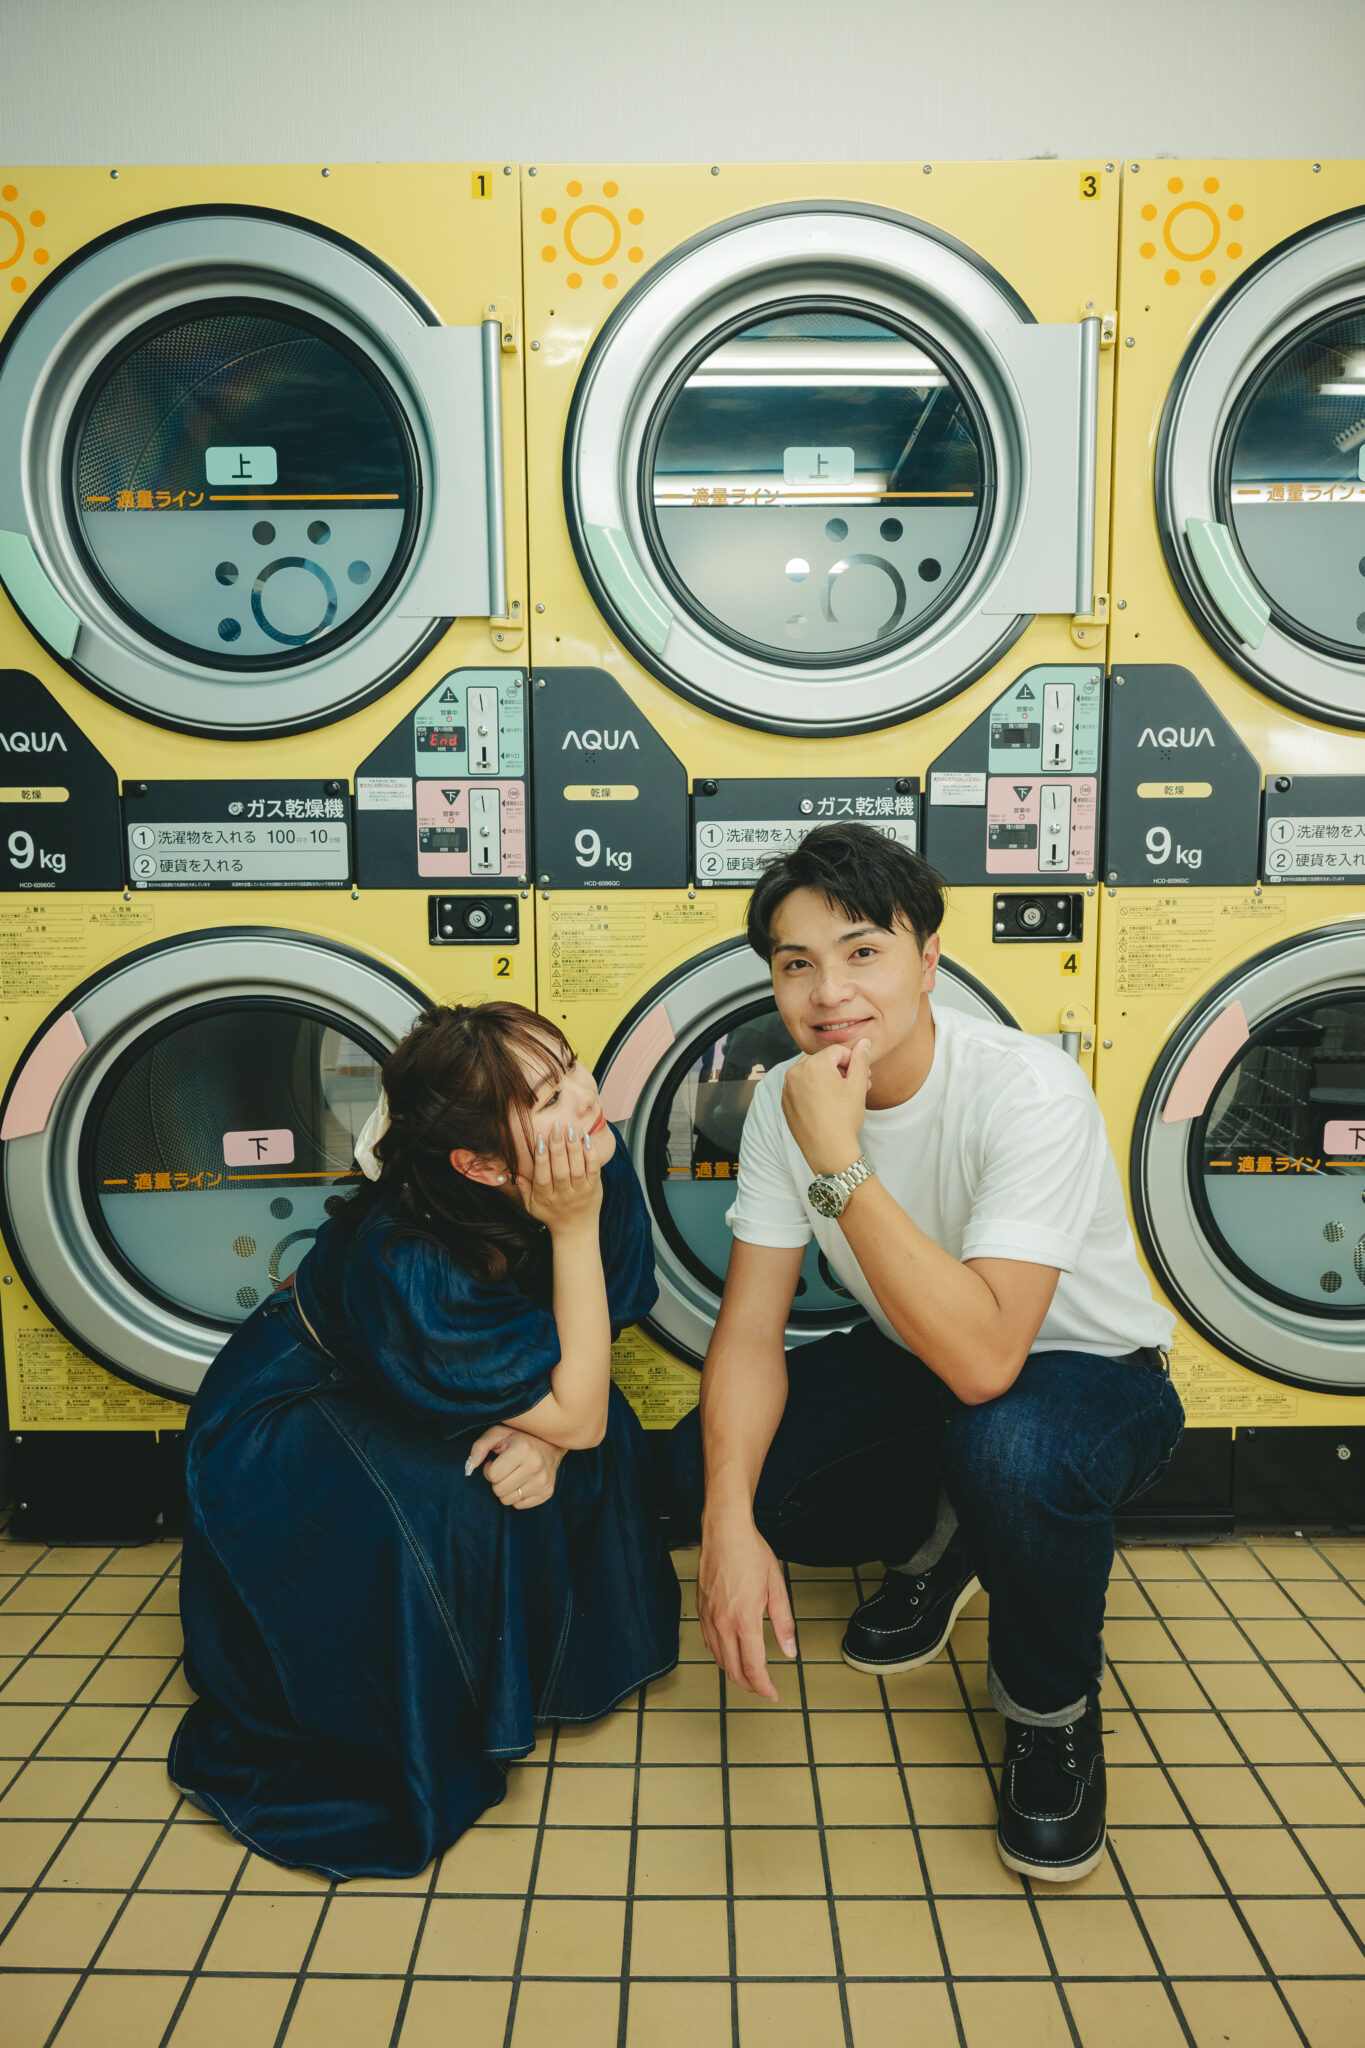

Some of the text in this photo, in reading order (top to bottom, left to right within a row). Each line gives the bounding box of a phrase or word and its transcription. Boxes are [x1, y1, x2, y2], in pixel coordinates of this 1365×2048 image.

[477, 175, 485, 196] 1
[1083, 176, 1098, 198] 3
[232, 453, 252, 478] 上
[809, 453, 829, 478] 上
[116, 490, 205, 509] 適量ライン
[691, 487, 779, 506] 適量ライン
[1267, 484, 1355, 501] 適量ライン
[444, 690, 454, 702] 上
[1020, 687, 1030, 698] 上
[430, 733, 458, 746] End
[562, 730, 640, 750] AQUA
[1137, 727, 1215, 748] AQUA
[21, 789, 42, 800] 乾燥
[446, 791, 457, 802] 下
[590, 787, 611, 798] 乾燥
[1017, 787, 1028, 798] 下
[1163, 785, 1185, 796] 乾燥
[247, 798, 344, 819] ガス乾燥機
[817, 796, 914, 816] ガス乾燥機
[158, 830, 256, 845] 洗濯物を入れる
[160, 859, 243, 873] 硬貨を入れる
[496, 958, 510, 976] 2
[1063, 954, 1078, 973] 4
[248, 1138, 268, 1160] 下
[1237, 1156, 1321, 1172] 適量ライン
[134, 1172, 222, 1190] 適量ライン
